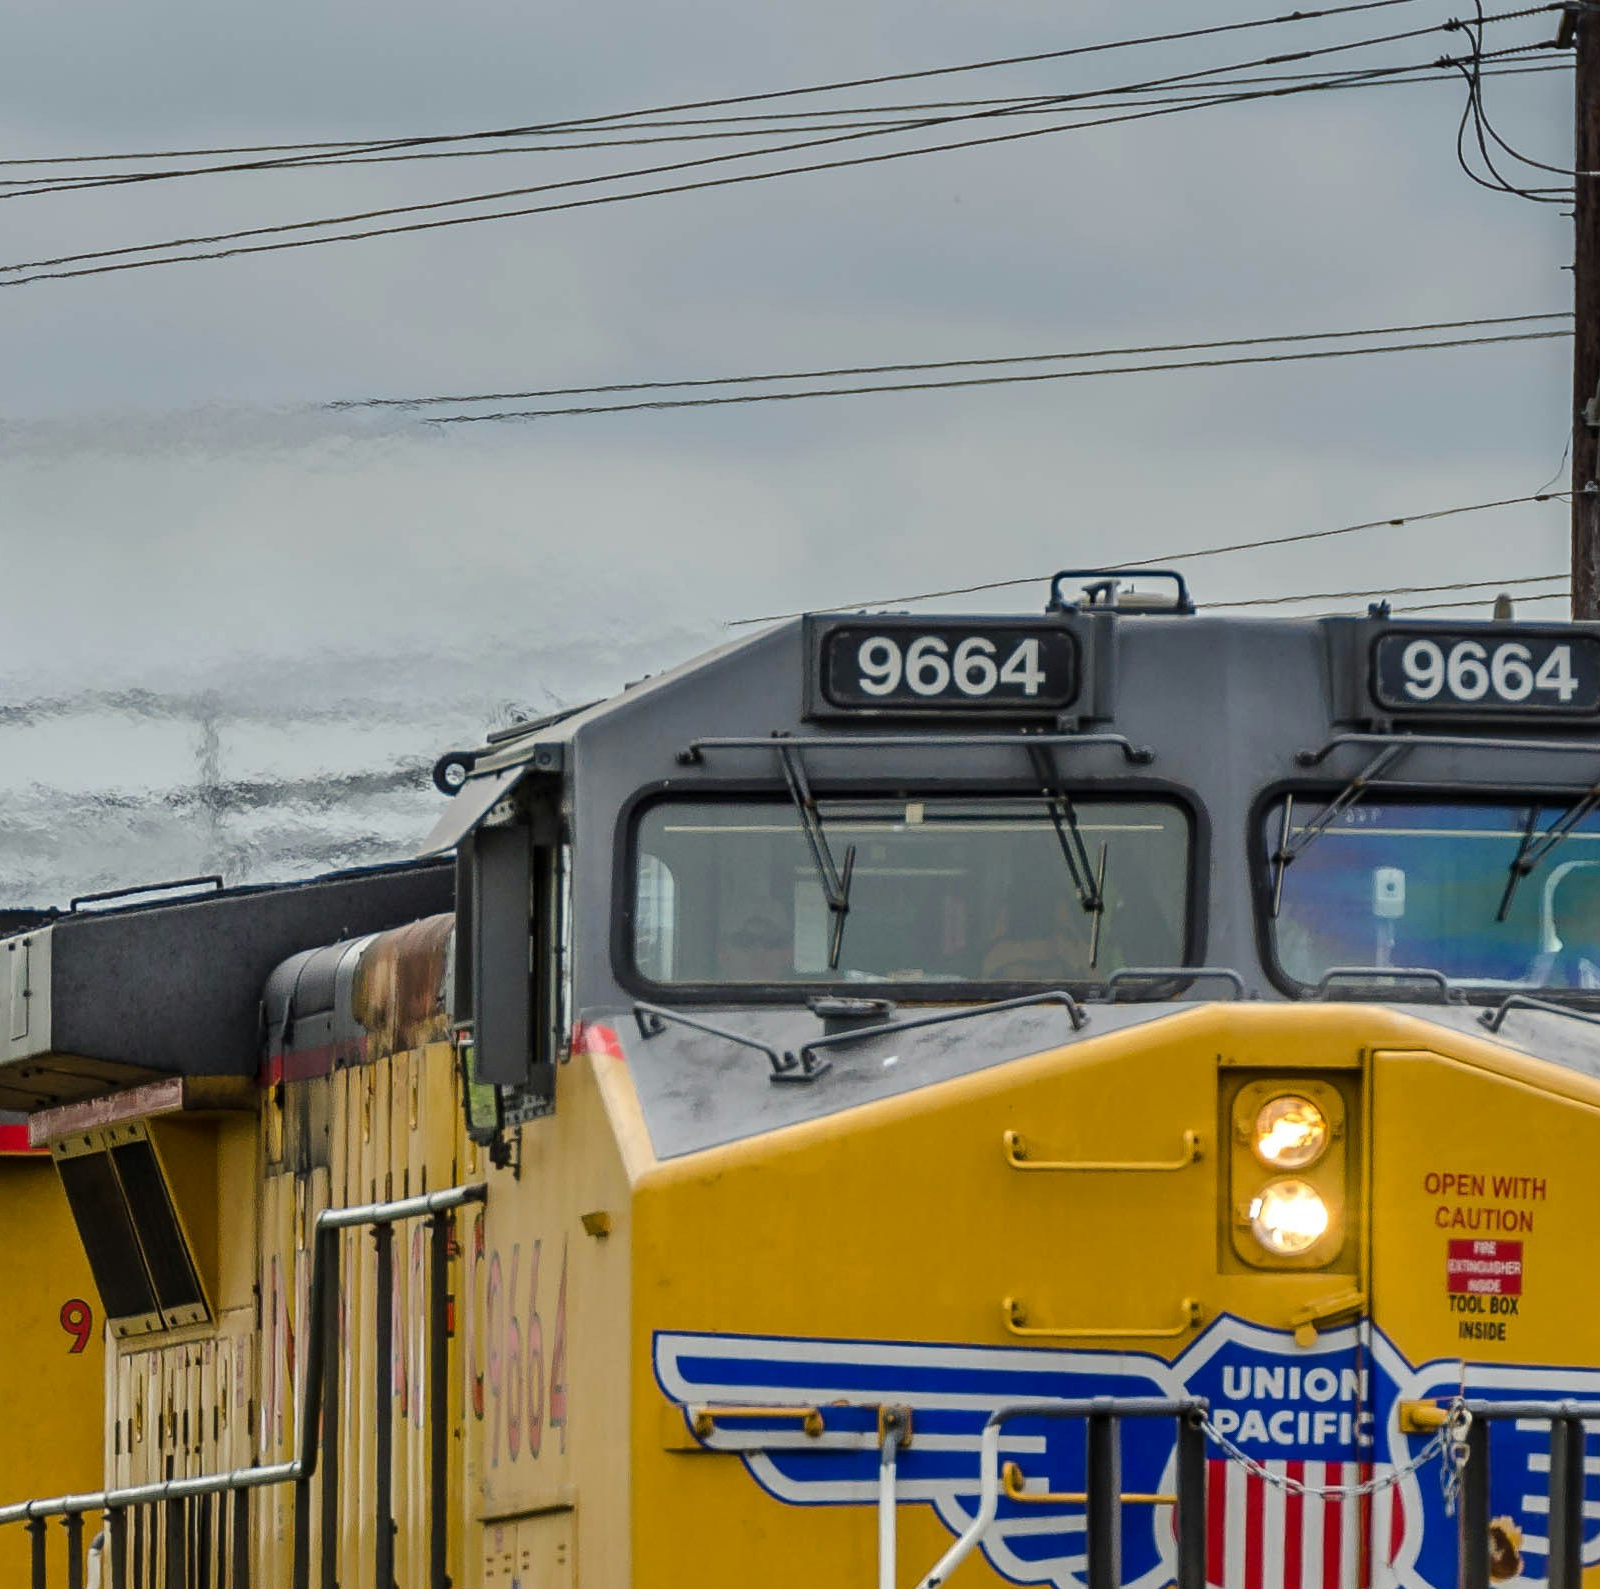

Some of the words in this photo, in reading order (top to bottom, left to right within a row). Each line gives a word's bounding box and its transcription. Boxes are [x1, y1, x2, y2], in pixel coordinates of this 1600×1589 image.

[857, 637, 1046, 696] 9664
[1402, 638, 1579, 701] 9664
[1424, 1172, 1485, 1196] OPEN
[1492, 1175, 1546, 1200] WITH
[1435, 1205, 1534, 1232] CAUTION
[1473, 1240, 1497, 1255] FIRE
[1448, 1258, 1522, 1275] EXTINGUISHER
[1467, 1278, 1501, 1293] INSIDE
[1449, 1294, 1486, 1314] TOOL
[1490, 1296, 1519, 1316] BOX
[1459, 1321, 1506, 1341] INSIDE
[486, 1231, 568, 1468] 9664
[1222, 1365, 1369, 1402] UNION
[1213, 1409, 1375, 1446] PACIFIC
